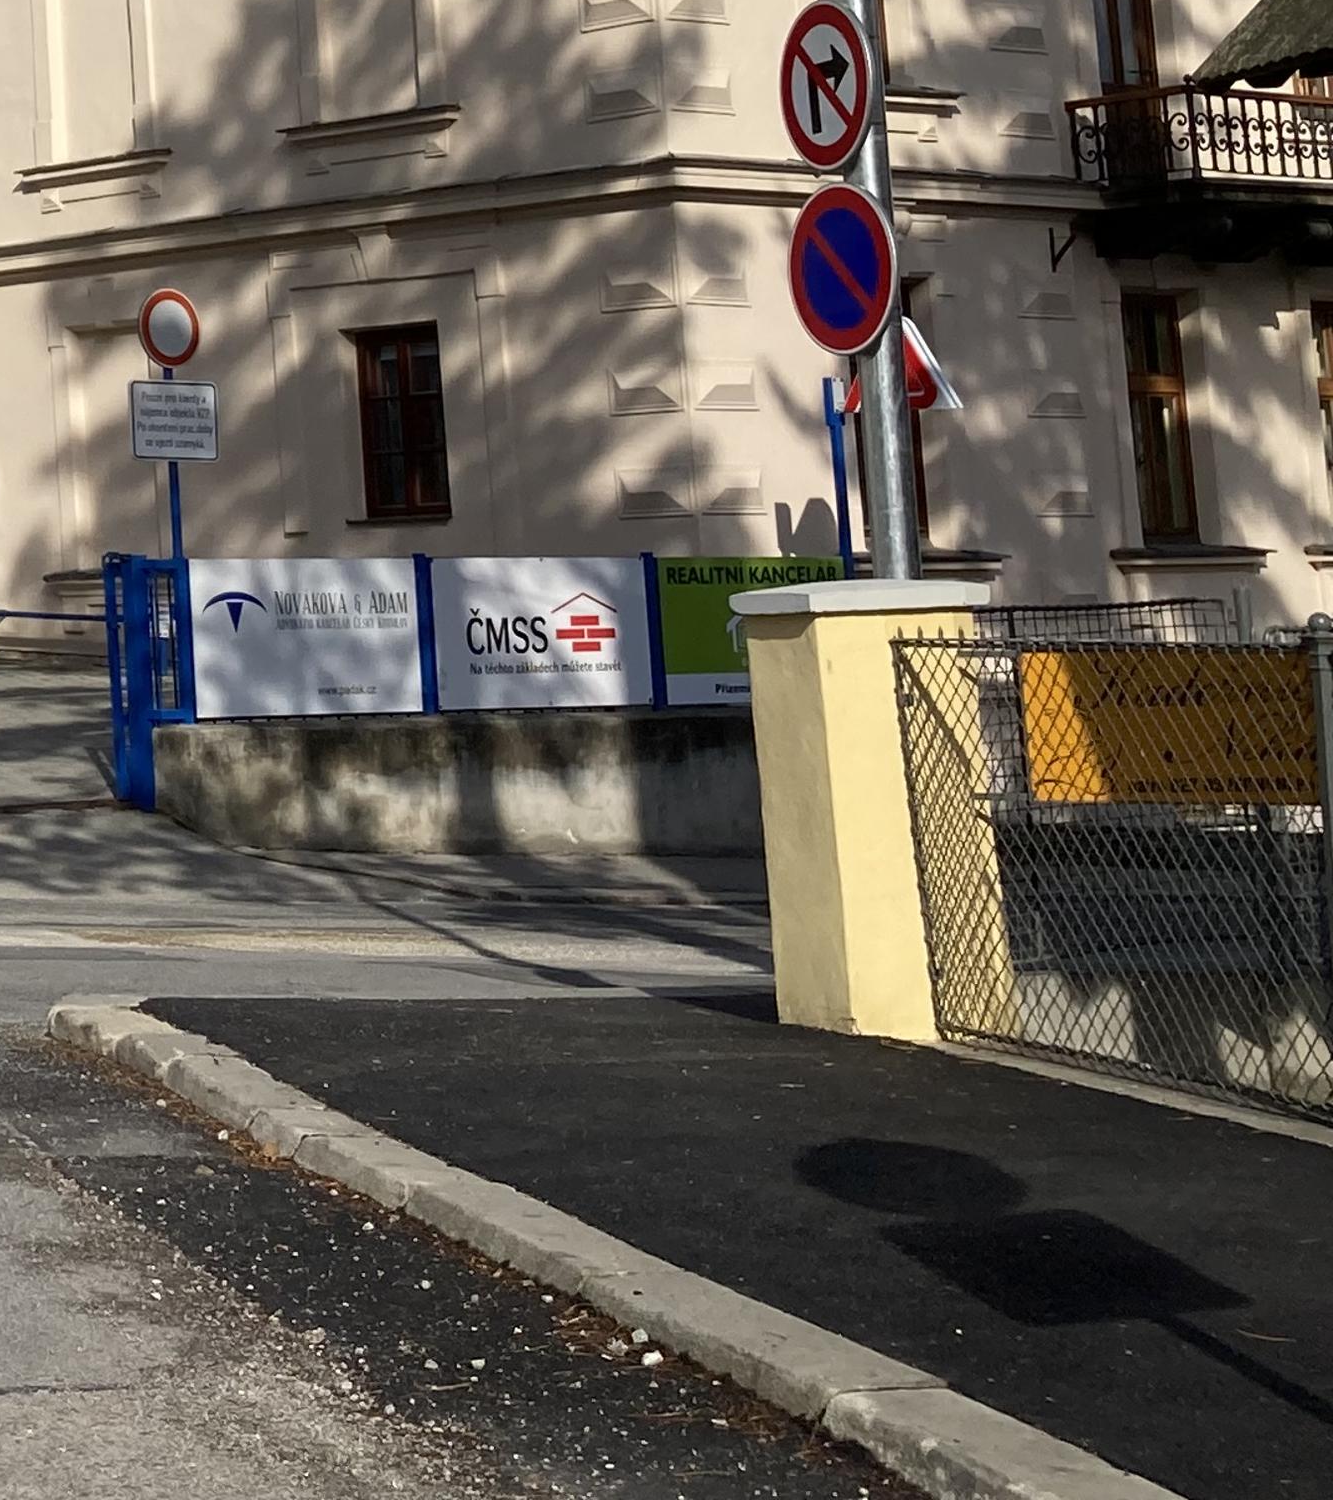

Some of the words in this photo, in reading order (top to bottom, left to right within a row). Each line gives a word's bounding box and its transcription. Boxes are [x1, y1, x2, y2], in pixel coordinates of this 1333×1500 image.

[369, 590, 408, 614] ADAM
[466, 608, 548, 655] ČMSS
[470, 663, 482, 675] Na
